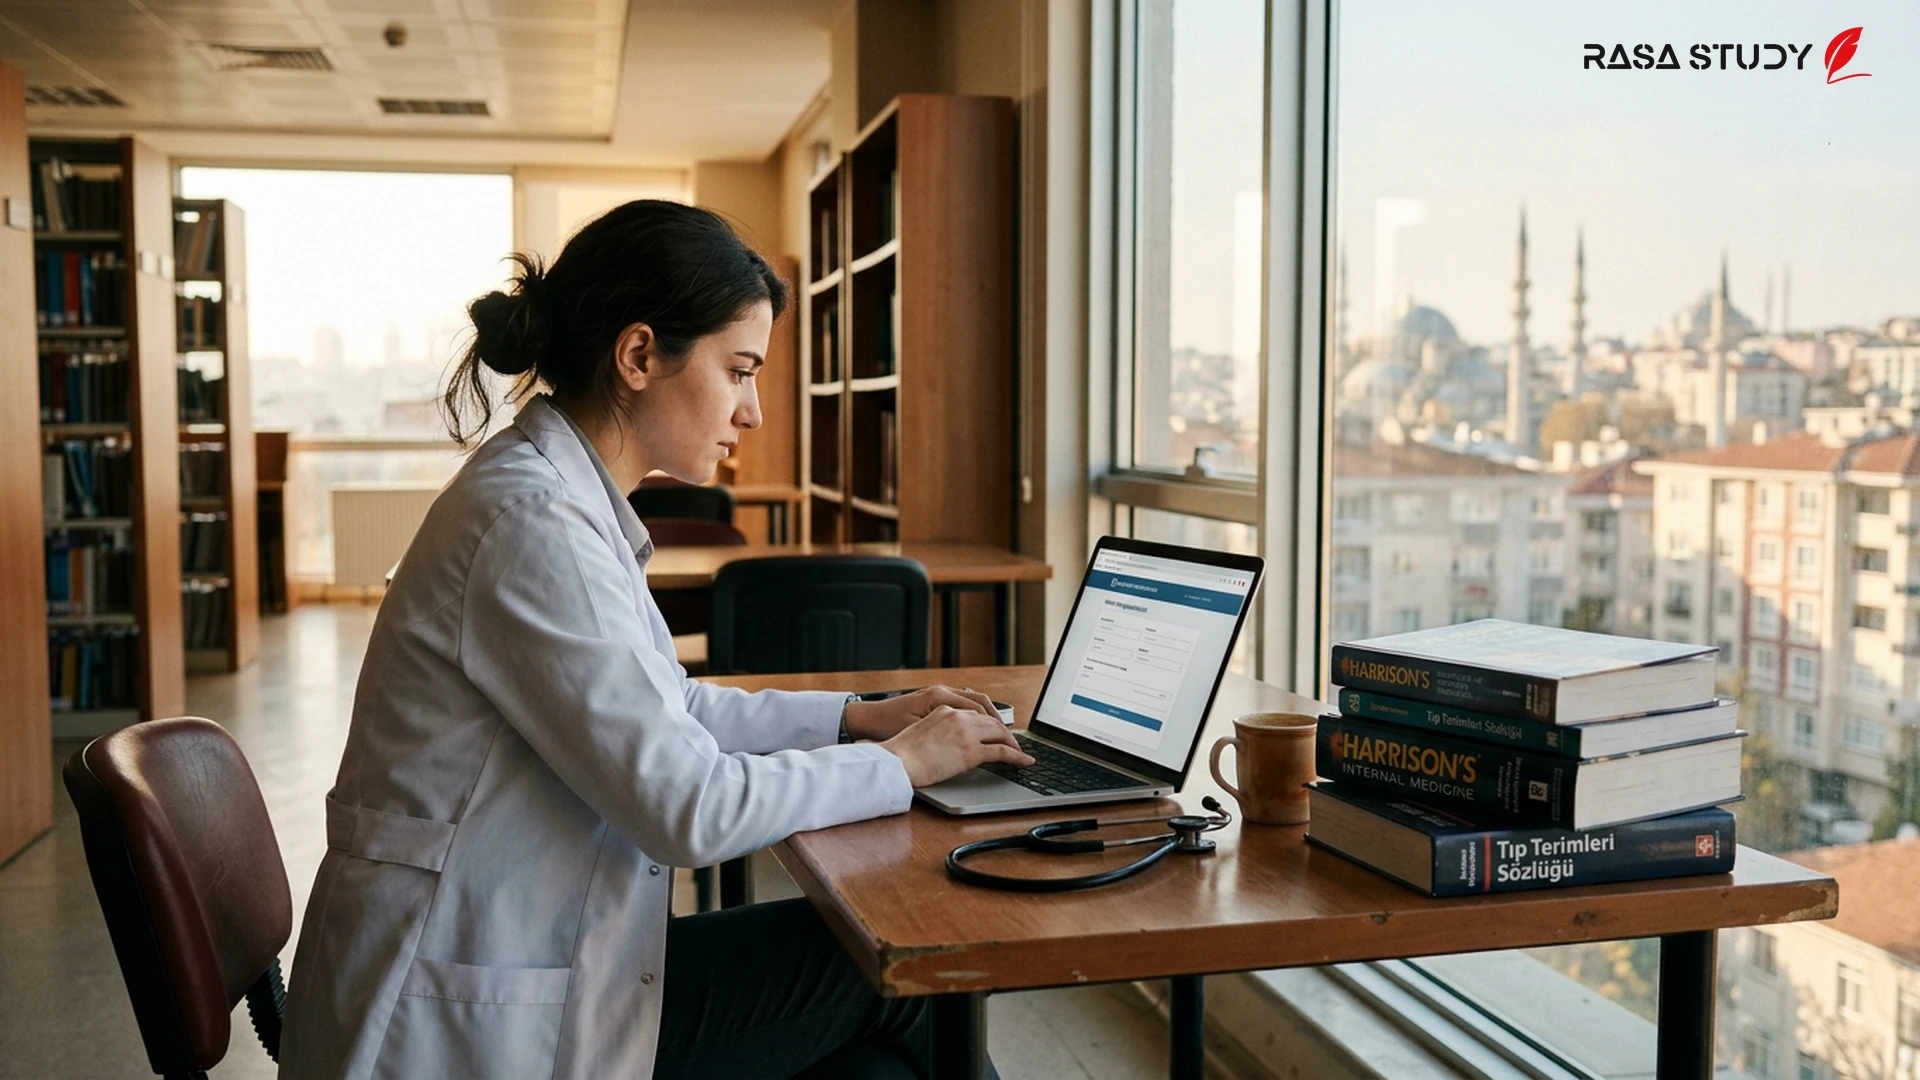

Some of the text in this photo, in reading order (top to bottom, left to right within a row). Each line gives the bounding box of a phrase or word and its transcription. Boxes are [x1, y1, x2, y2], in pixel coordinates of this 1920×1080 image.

[1349, 658, 1431, 690] HARRISON'S
[1342, 732, 1478, 784] HARRISON'S
[1341, 763, 1405, 786] INTERNAL
[1409, 777, 1475, 801] MEDICINE
[1497, 833, 1615, 863] Tıp Terimleri
[1497, 858, 1574, 882] Sözlüğü
